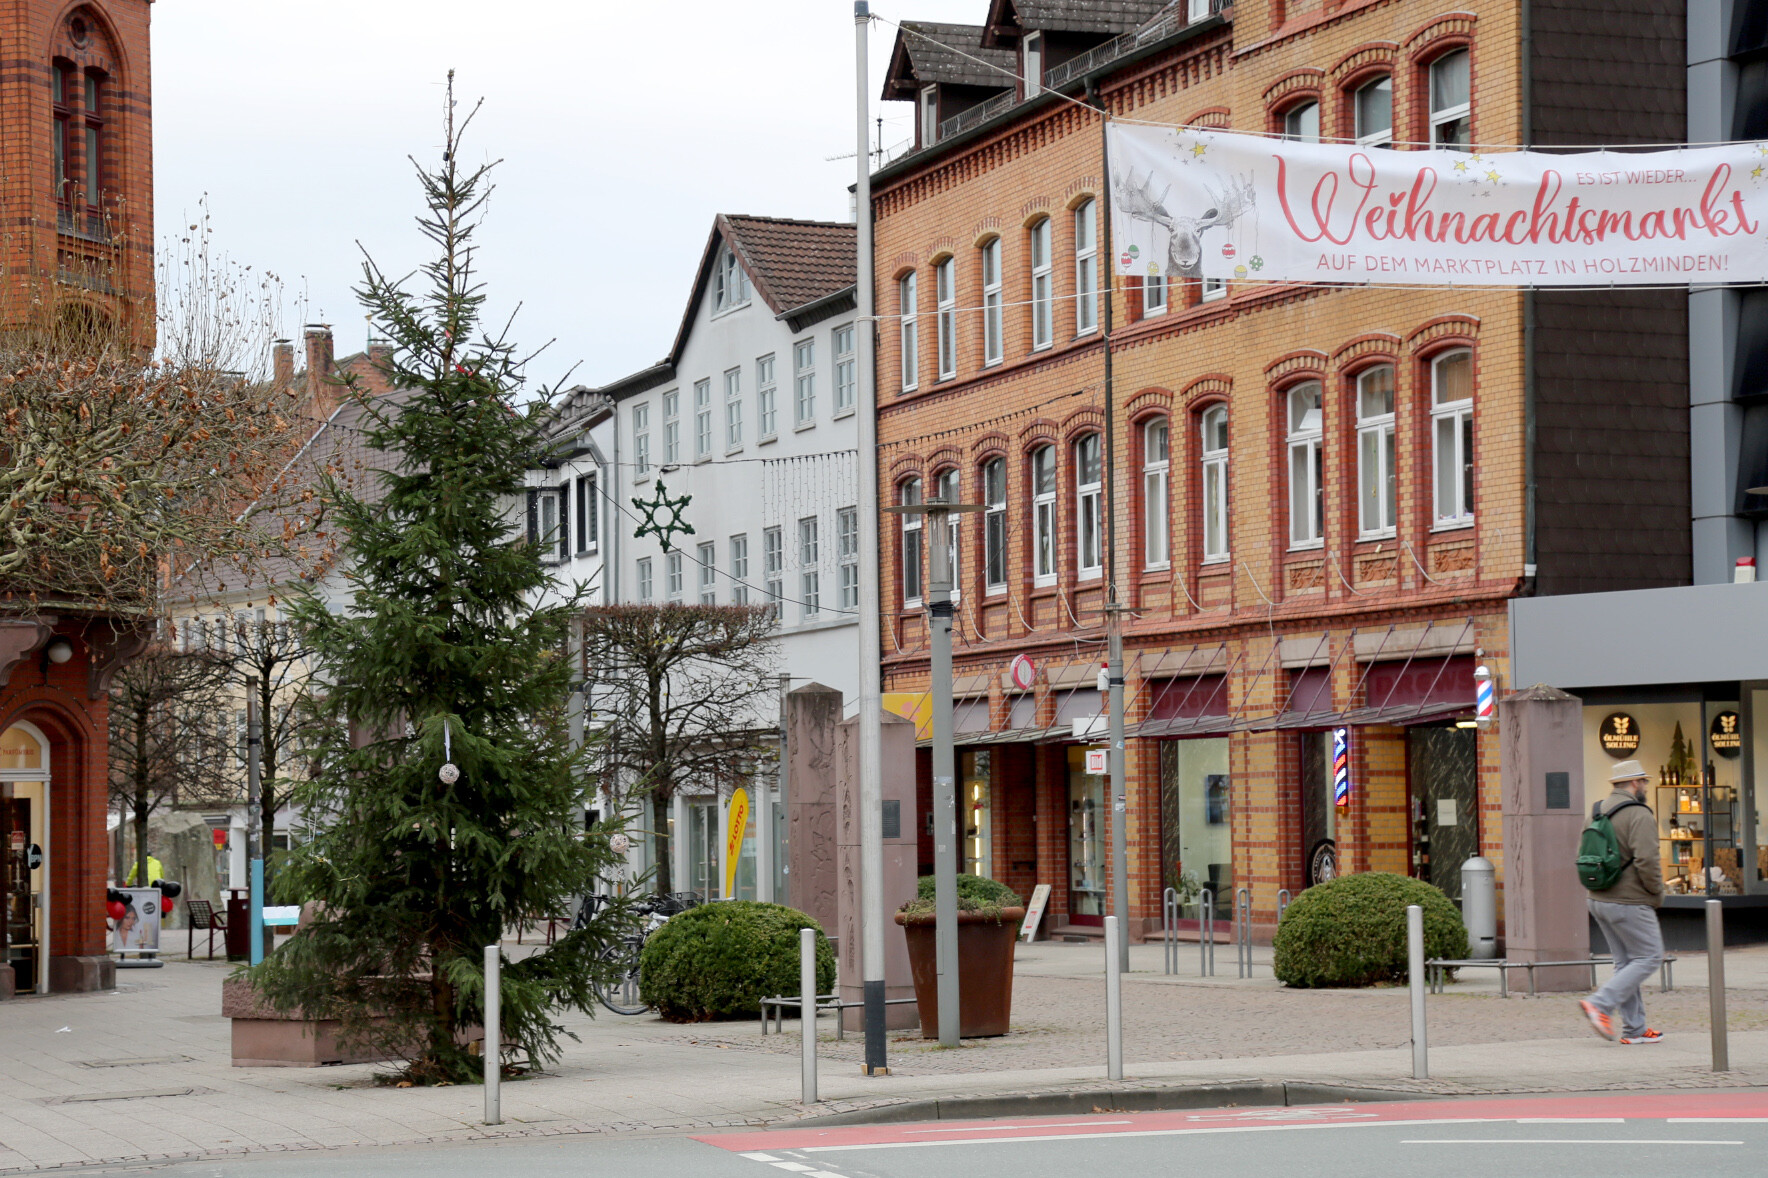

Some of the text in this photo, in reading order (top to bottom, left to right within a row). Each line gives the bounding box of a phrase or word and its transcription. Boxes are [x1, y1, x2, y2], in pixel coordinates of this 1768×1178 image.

[1577, 168, 1697, 186] ES IST WIEDER...
[1272, 152, 1758, 246] Weihnachtsmarkt
[1316, 253, 1730, 275] AUF DEM MARKTPLATZ IN HOLZMINDEN!
[1603, 733, 1639, 742] ÖLMÜHLE
[1605, 741, 1637, 749] SOLLING
[1711, 732, 1740, 741] ÖLMÜHL
[732, 804, 741, 840] LOTTO
